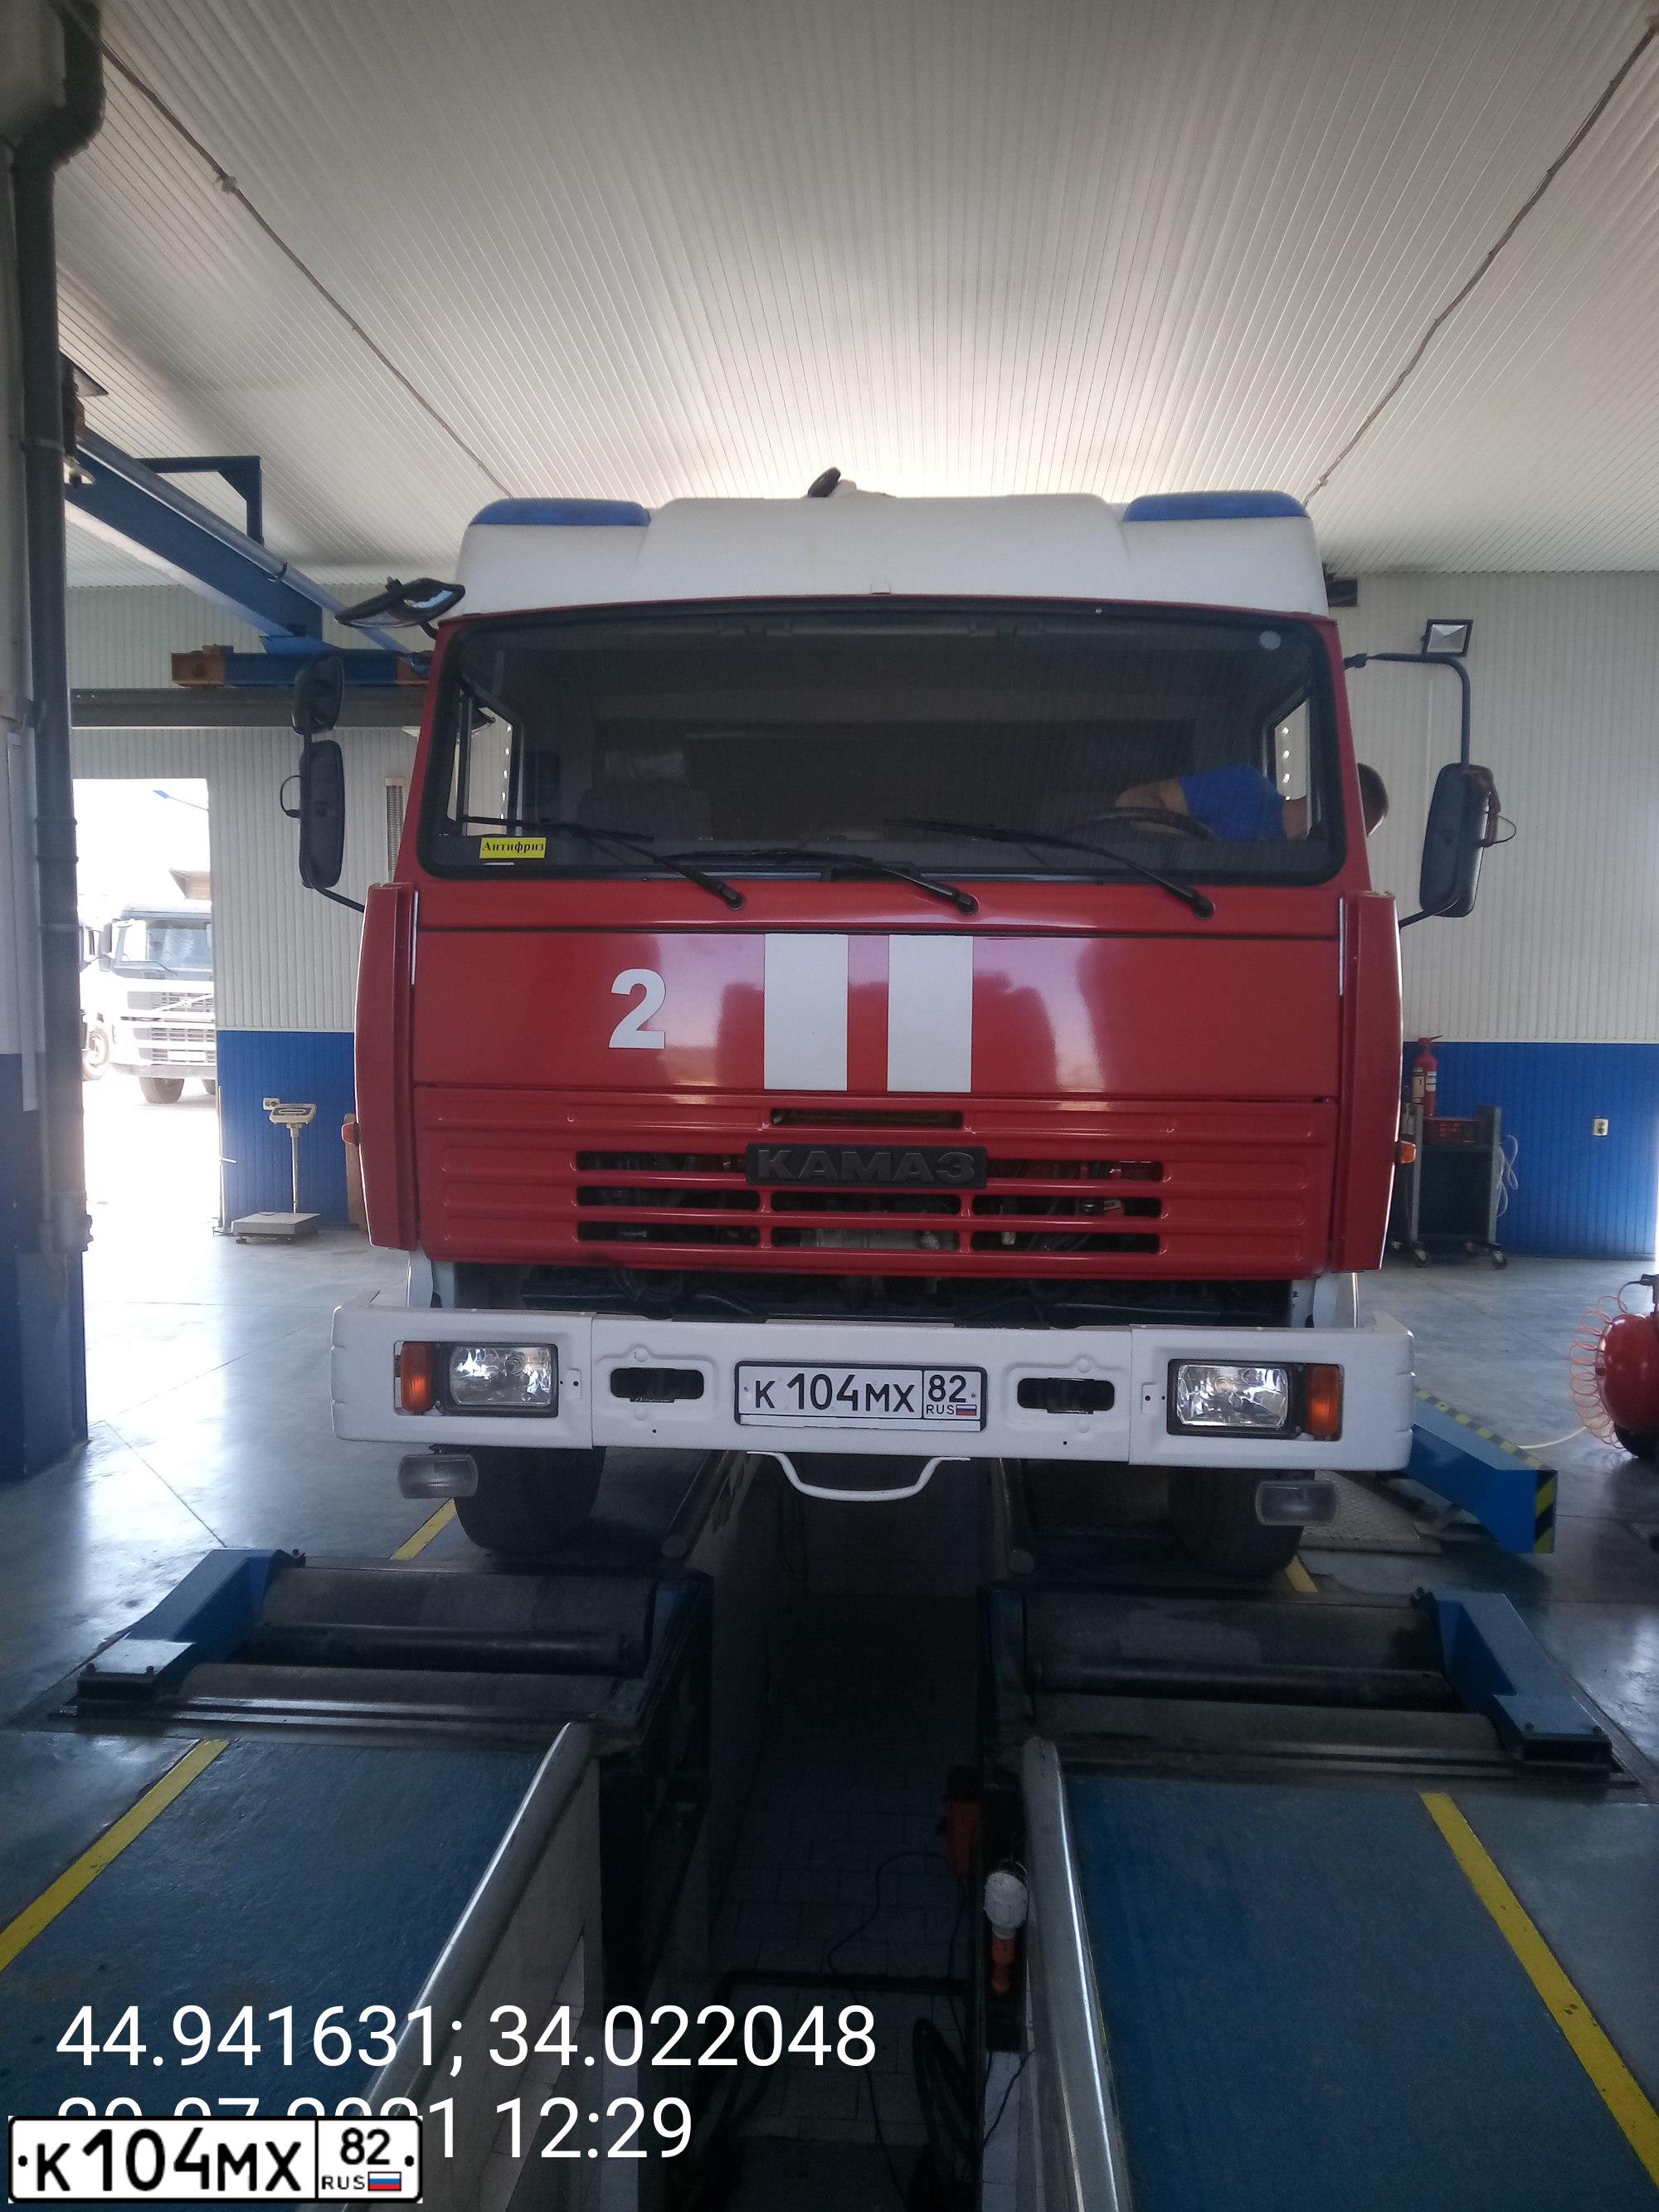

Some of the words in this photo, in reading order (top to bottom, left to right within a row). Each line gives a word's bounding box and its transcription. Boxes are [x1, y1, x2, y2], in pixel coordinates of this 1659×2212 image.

[481, 840, 544, 854] Антифриз
[608, 967, 666, 1050] 2
[757, 1149, 975, 1184] КАМАЗ
[927, 1374, 966, 1403] 82
[926, 1404, 954, 1415] RUS
